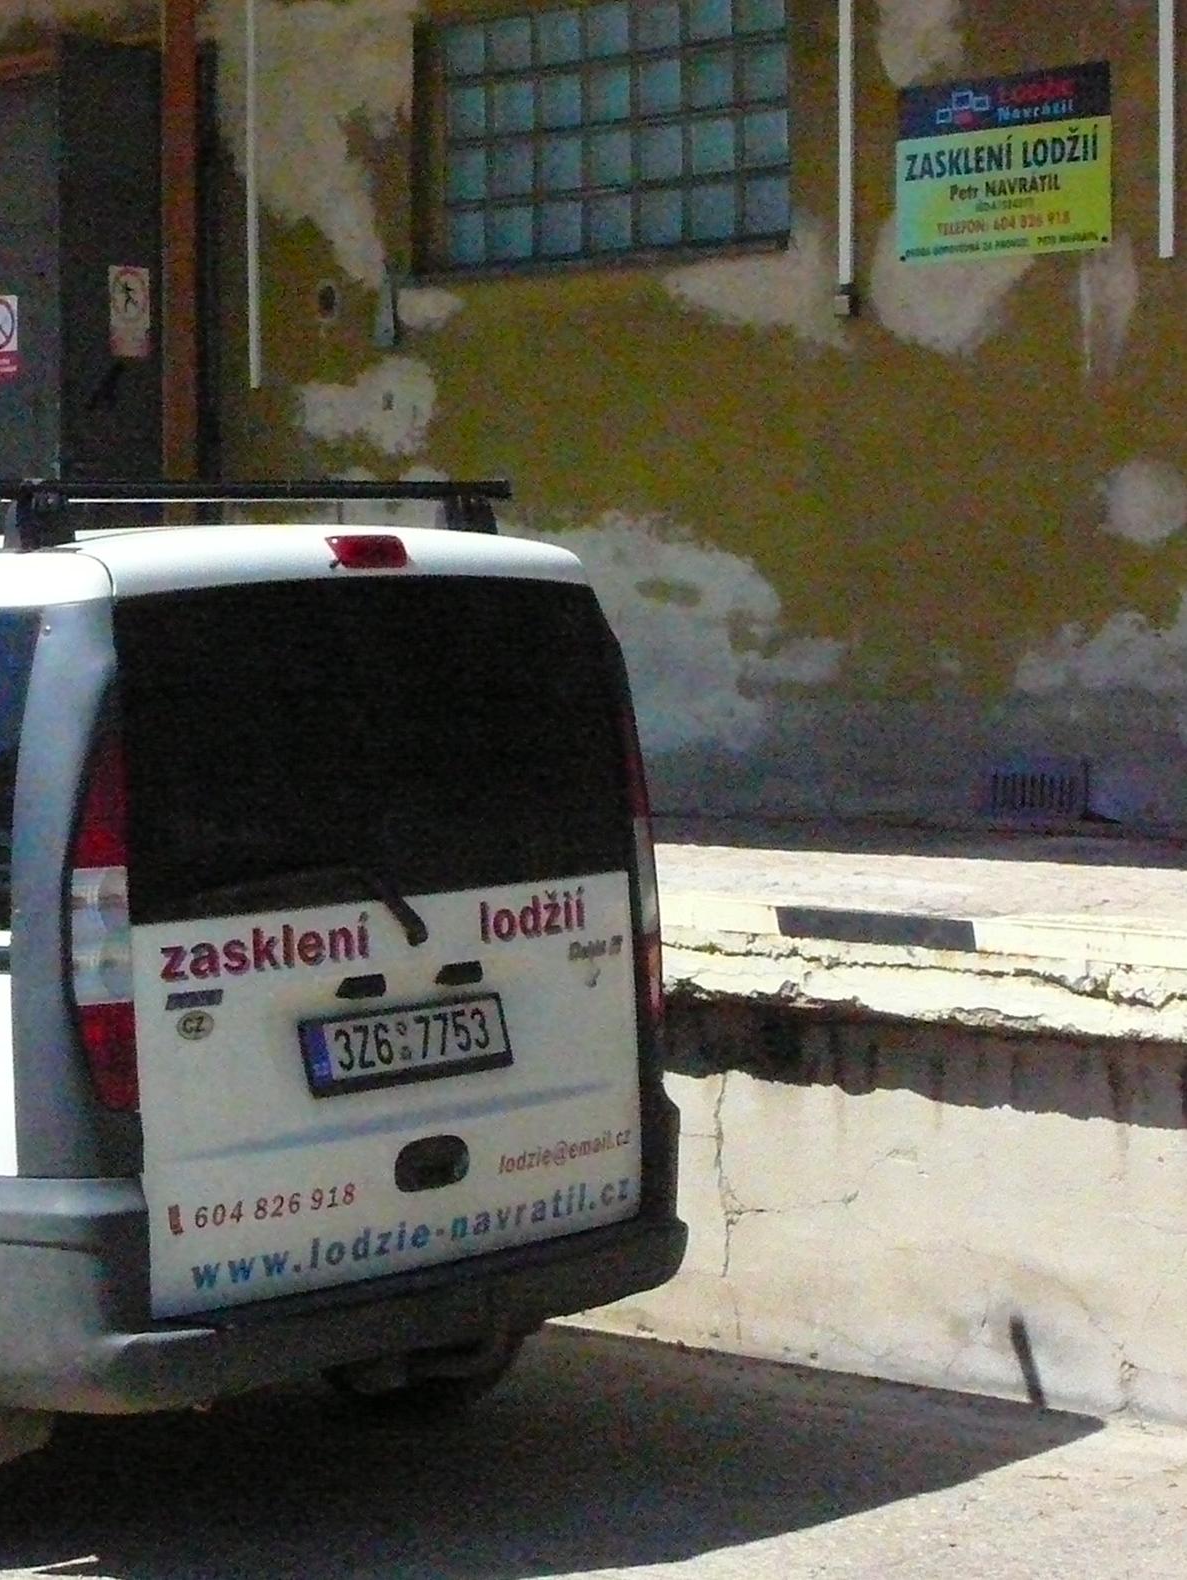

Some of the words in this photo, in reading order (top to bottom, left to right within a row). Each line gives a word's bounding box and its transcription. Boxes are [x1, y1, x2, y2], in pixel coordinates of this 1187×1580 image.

[904, 134, 1013, 181] ZASKLENÍ
[1022, 124, 1099, 168] LODŽIÍ
[949, 183, 979, 201] Petr
[160, 911, 370, 982] zasklení
[182, 1015, 205, 1033] CZ
[333, 1021, 394, 1072] 3Z6
[414, 1007, 490, 1060] 7753
[498, 1128, 632, 1175] lodzie@email.cz
[194, 1199, 244, 1229] 604
[253, 1191, 301, 1221] 826
[310, 1181, 357, 1211] 918
[190, 1177, 631, 1290] www.lodzie-navratil.cz
